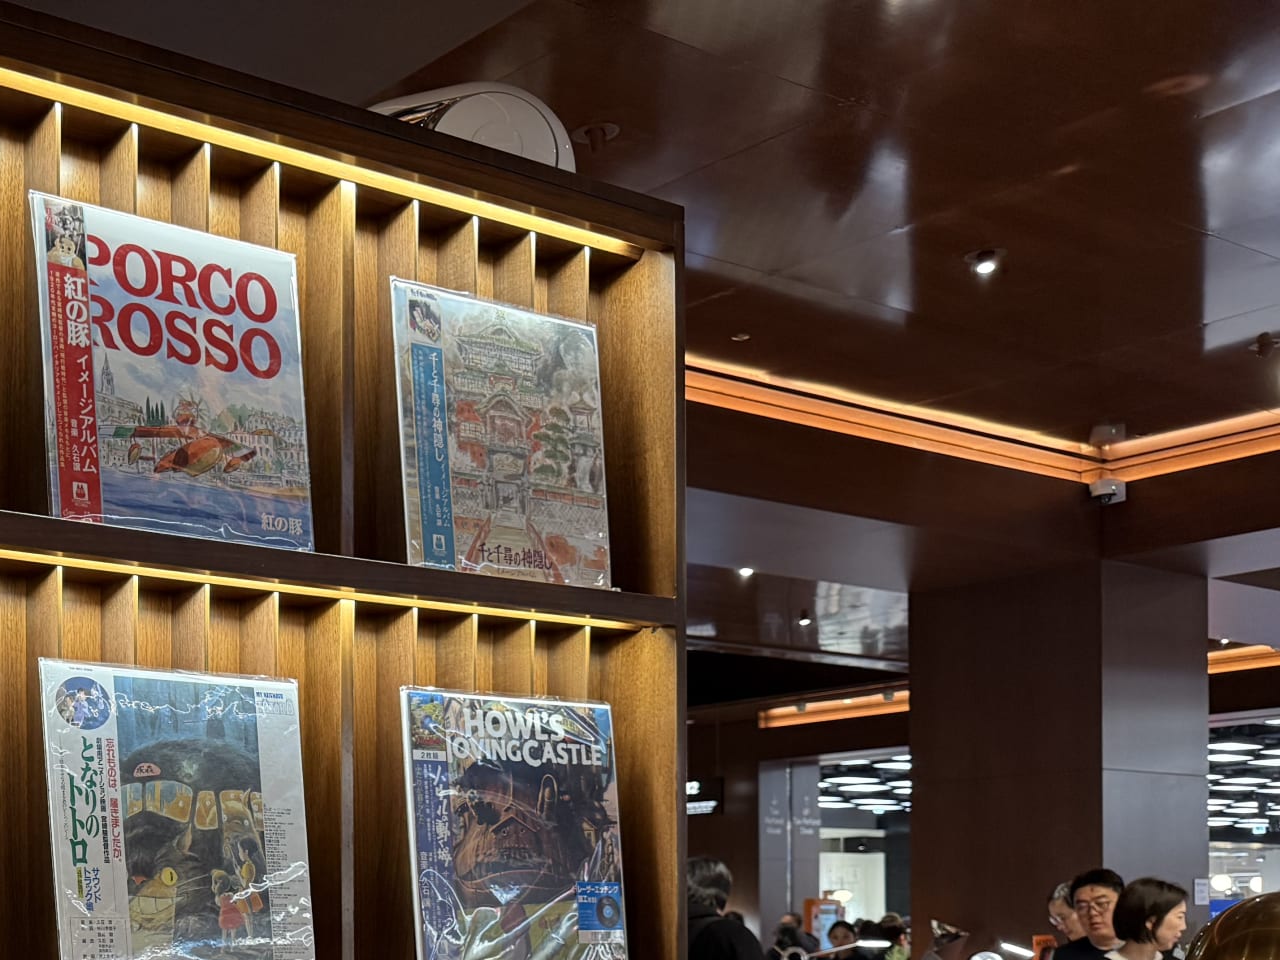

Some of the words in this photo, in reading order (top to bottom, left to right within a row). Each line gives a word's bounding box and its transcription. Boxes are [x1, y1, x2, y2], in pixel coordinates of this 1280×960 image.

[63, 272, 91, 348] 紅の豚
[87, 234, 278, 324] PORCO
[90, 294, 282, 380] ROSSO
[76, 354, 97, 474] イメージアルバム
[428, 352, 445, 462] 千と千尋の神隠し
[261, 512, 303, 535] 紅の豚
[478, 542, 552, 570] 千と千尋の神隠し
[463, 707, 565, 742] HOWL'S
[522, 739, 602, 768] CASTLE
[67, 773, 88, 867] トトロ
[77, 736, 100, 838] となりの
[91, 867, 102, 903] サウンド
